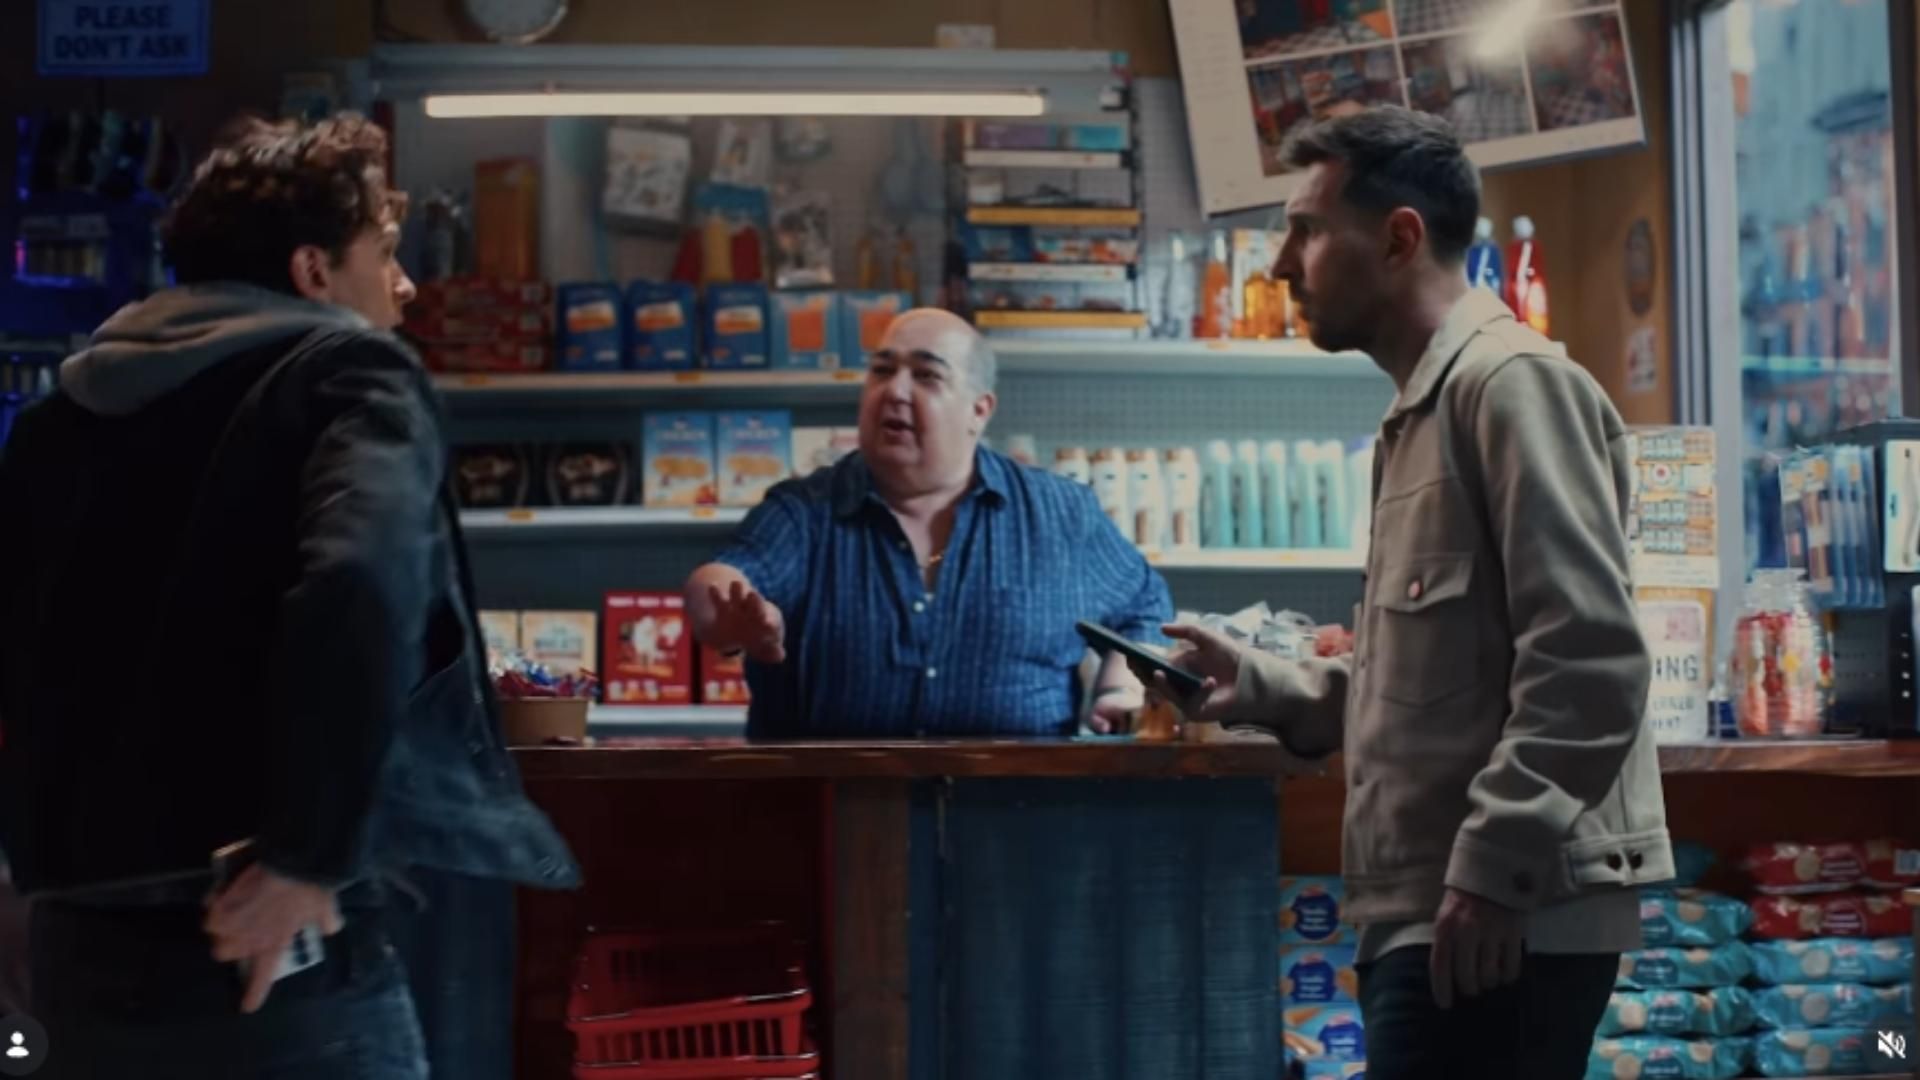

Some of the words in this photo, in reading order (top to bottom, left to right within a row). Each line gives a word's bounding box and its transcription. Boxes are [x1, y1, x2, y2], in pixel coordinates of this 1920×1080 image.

[76, 5, 170, 28] PLEASE
[55, 35, 131, 59] DON'T
[137, 35, 189, 58] ASK
